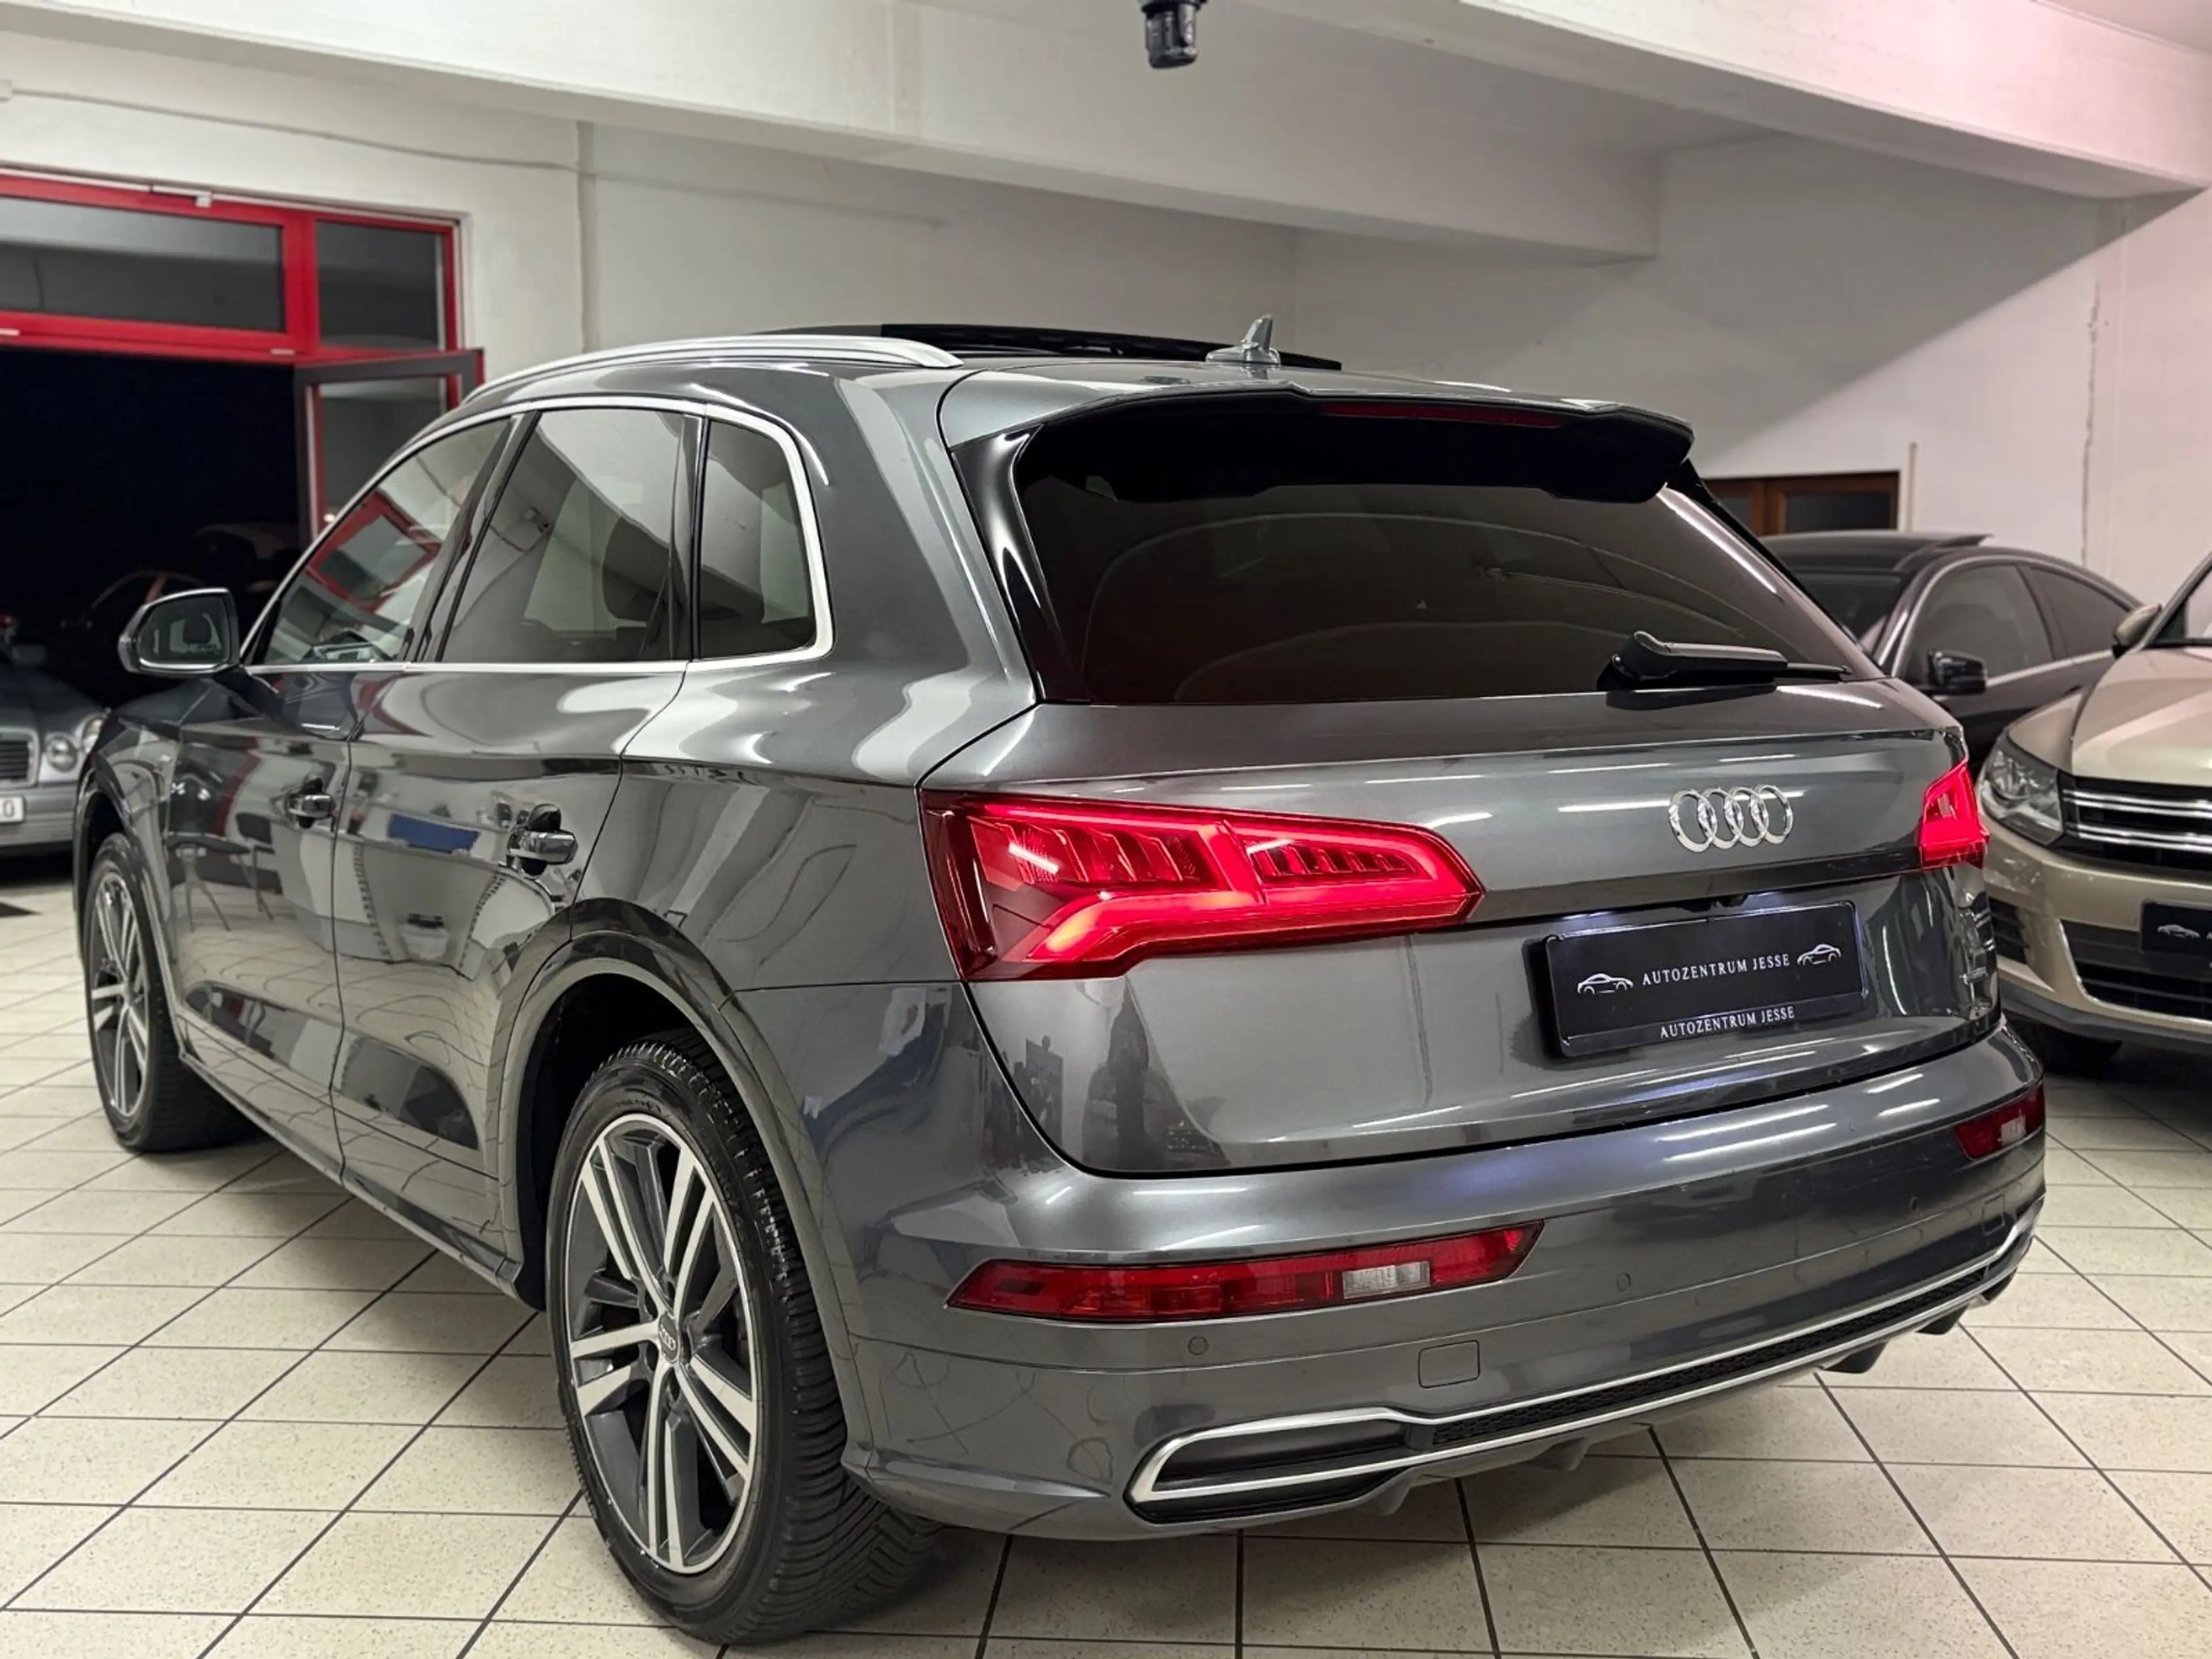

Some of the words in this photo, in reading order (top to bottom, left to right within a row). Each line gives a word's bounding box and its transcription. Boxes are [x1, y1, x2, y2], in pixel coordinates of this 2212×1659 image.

[1642, 959, 1748, 986] AUTOZENTRUM
[1753, 953, 1790, 971] JESSE
[1660, 1012, 1756, 1039] AUTOZENTRUM
[1761, 1006, 1795, 1023] JESSE
